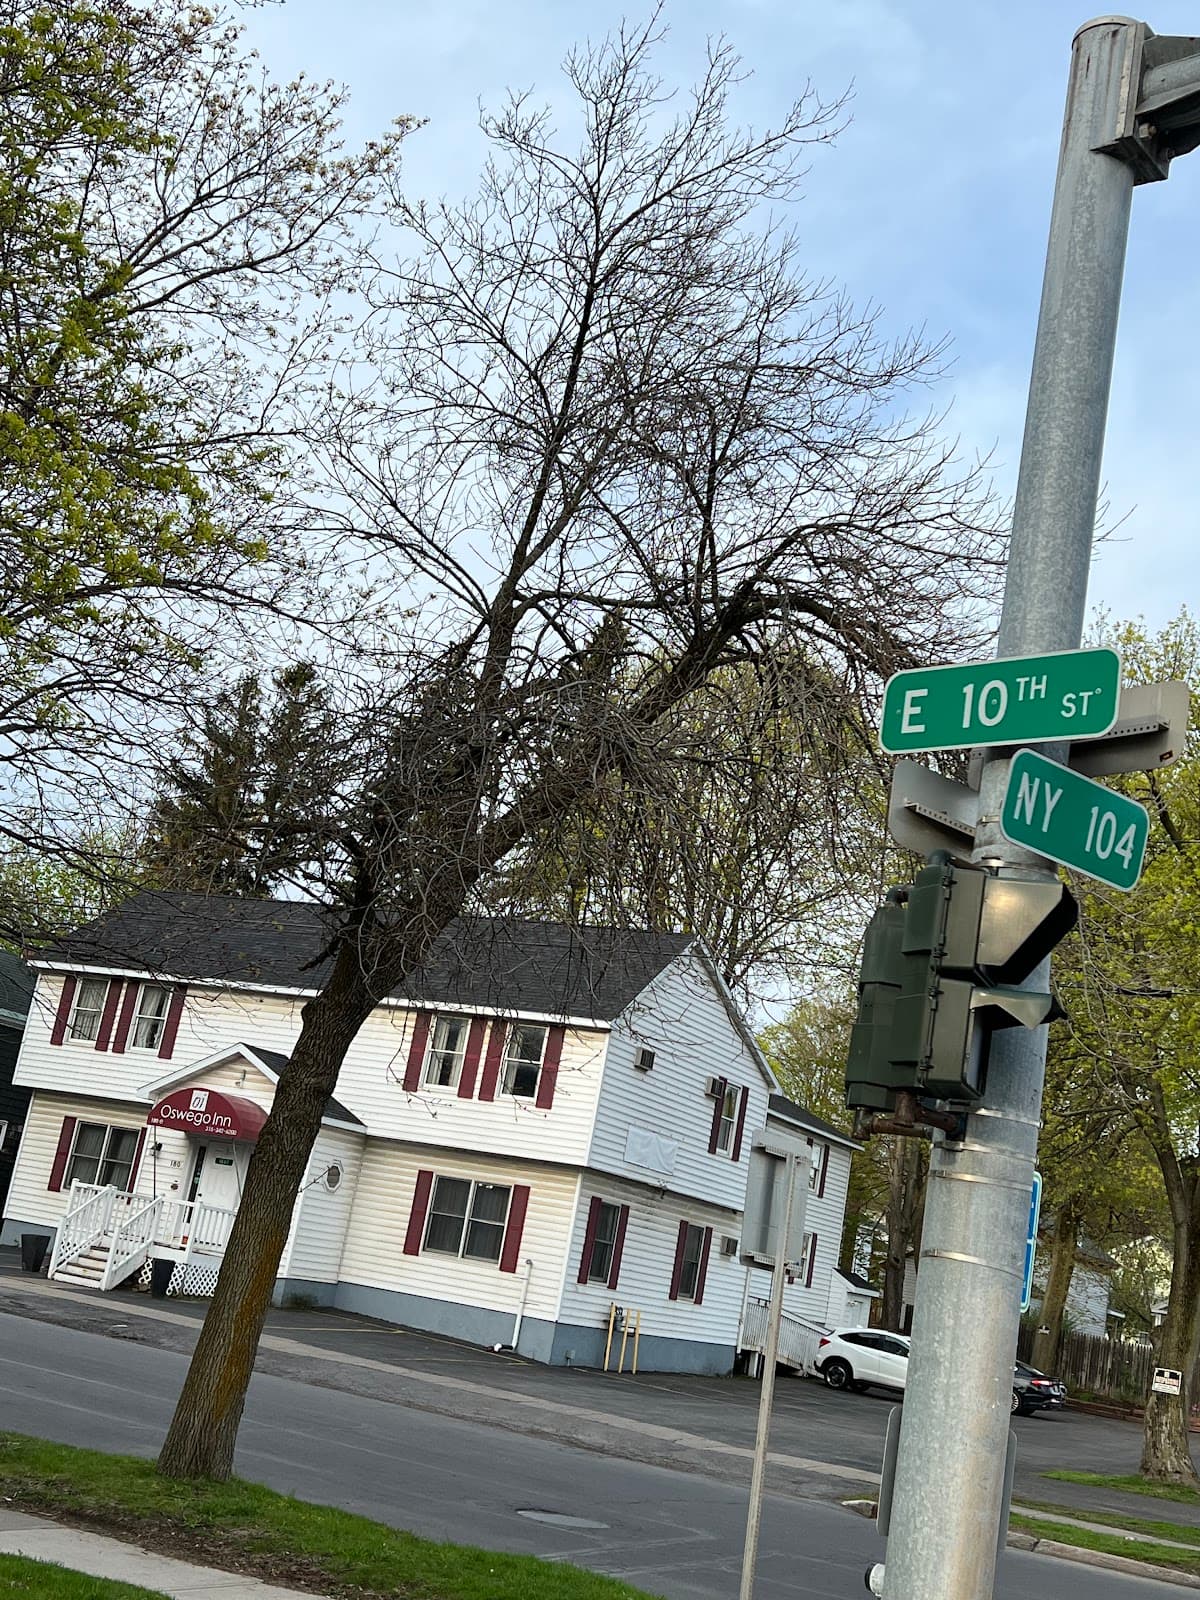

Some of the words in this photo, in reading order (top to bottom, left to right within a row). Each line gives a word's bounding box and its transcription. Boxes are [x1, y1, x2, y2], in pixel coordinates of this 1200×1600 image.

[901, 688, 929, 734] E
[1060, 691, 1093, 718] ST
[1013, 771, 1063, 833] NY
[1085, 806, 1137, 870] 104
[160, 1104, 211, 1126] Oswego
[212, 1112, 232, 1127] Inn
